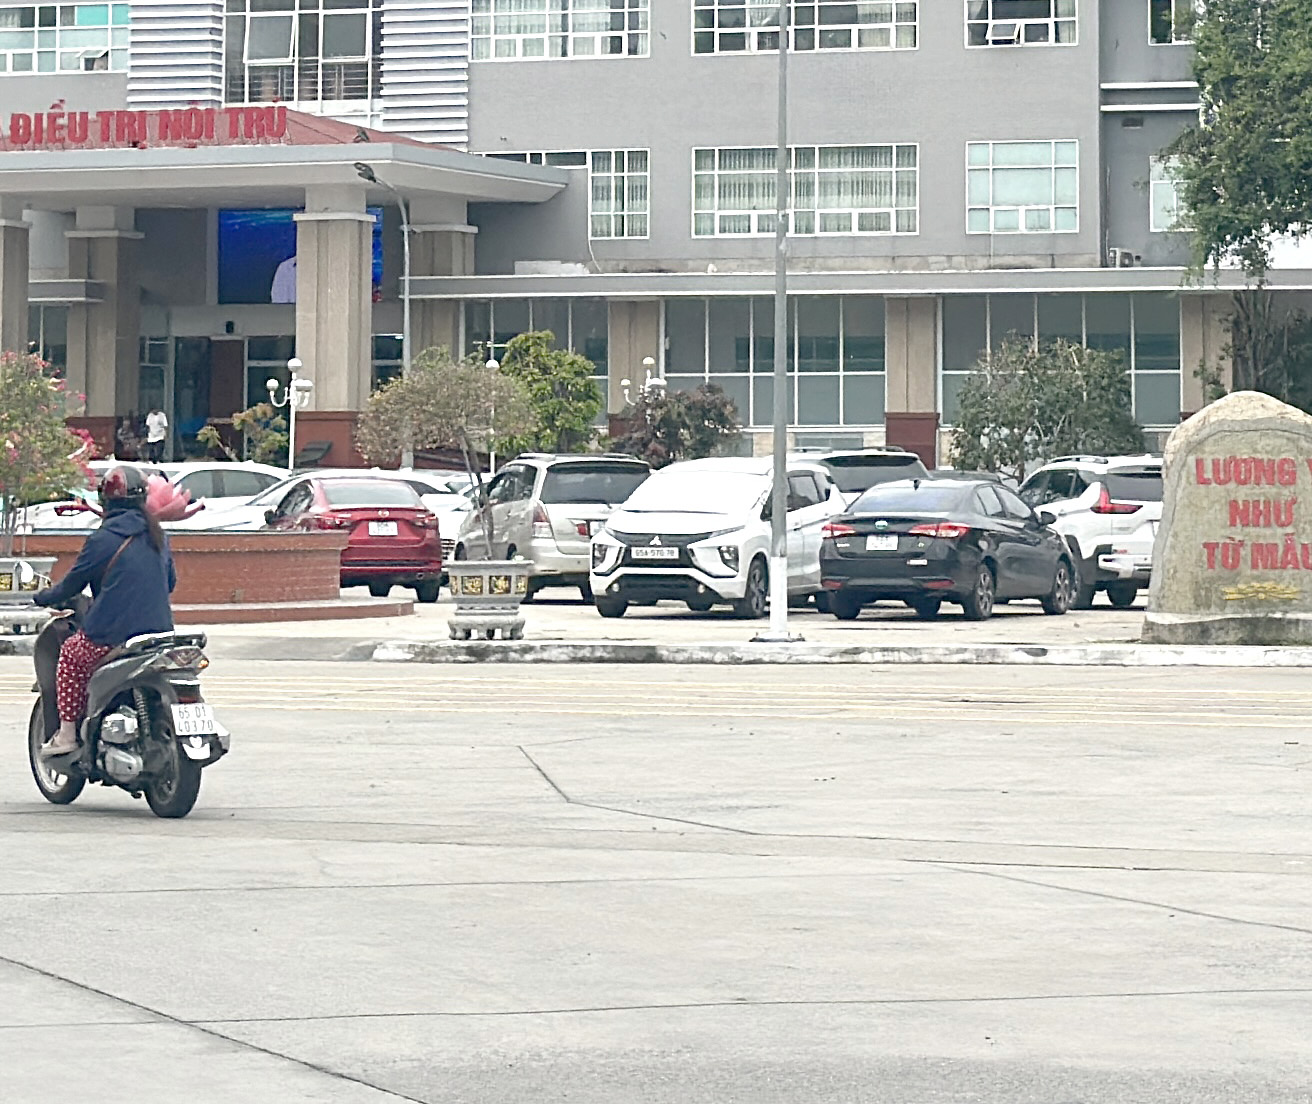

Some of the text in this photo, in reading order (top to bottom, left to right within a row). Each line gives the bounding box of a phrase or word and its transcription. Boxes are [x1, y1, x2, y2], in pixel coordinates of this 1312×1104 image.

[10, 98, 89, 145] ĐIỀU
[96, 110, 147, 149] TRỊ
[158, 101, 215, 148] NỘI
[225, 97, 288, 140] TRÚ
[1196, 456, 1297, 486] LƯƠNG
[1228, 496, 1297, 527] NHƯ
[1202, 537, 1245, 570] TỪ
